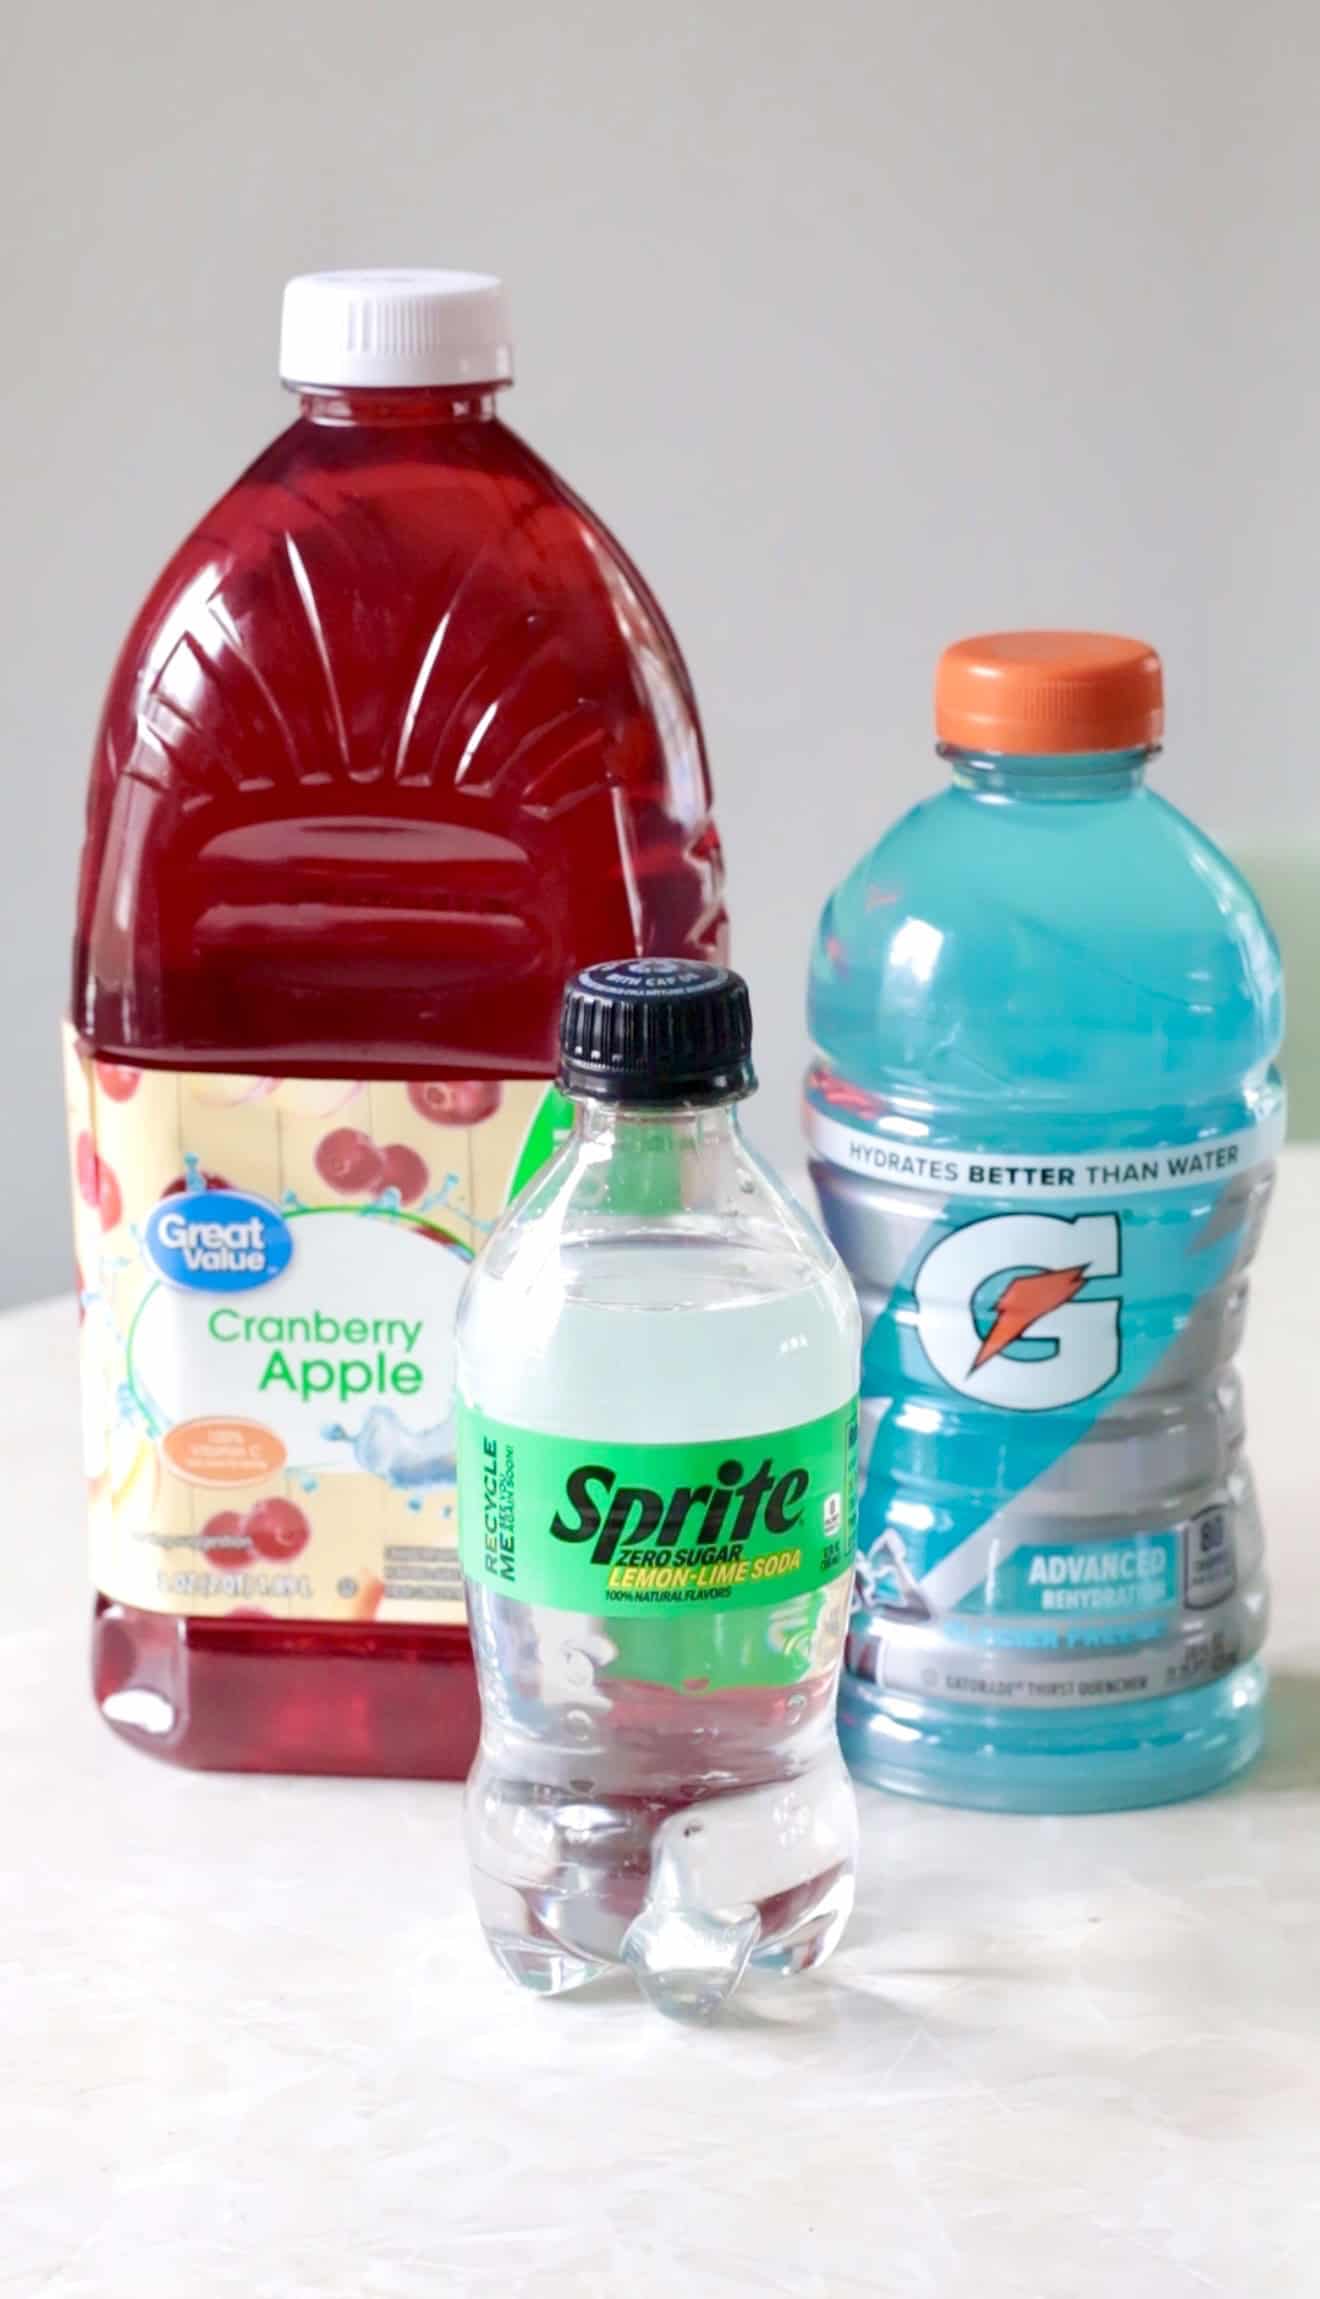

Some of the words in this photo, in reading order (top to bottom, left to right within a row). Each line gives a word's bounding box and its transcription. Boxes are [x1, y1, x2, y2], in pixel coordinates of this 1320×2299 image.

[850, 1141, 959, 1182] HYDRATES
[969, 1165, 1075, 1186] BETTER
[1086, 1161, 1159, 1184] THAN
[1167, 1145, 1239, 1177] WATER
[158, 1213, 264, 1249] Great
[183, 1248, 265, 1271] Value
[208, 1308, 423, 1352] Cranberry
[912, 1211, 1123, 1413] G
[259, 1349, 423, 1403] Apple
[483, 1436, 498, 1575] RECYCLE
[549, 1457, 810, 1565] Sprite
[499, 1532, 515, 1582] ME
[609, 1561, 749, 1588] LEMON-LIME
[751, 1549, 801, 1580] SODA
[616, 1549, 671, 1567] ZERO
[673, 1545, 743, 1567] SUGAR
[1027, 1547, 1167, 1585] ADVANCED
[606, 1590, 634, 1602] 100%
[635, 1589, 684, 1602] NATURAL
[684, 1586, 731, 1600] FLAVORS
